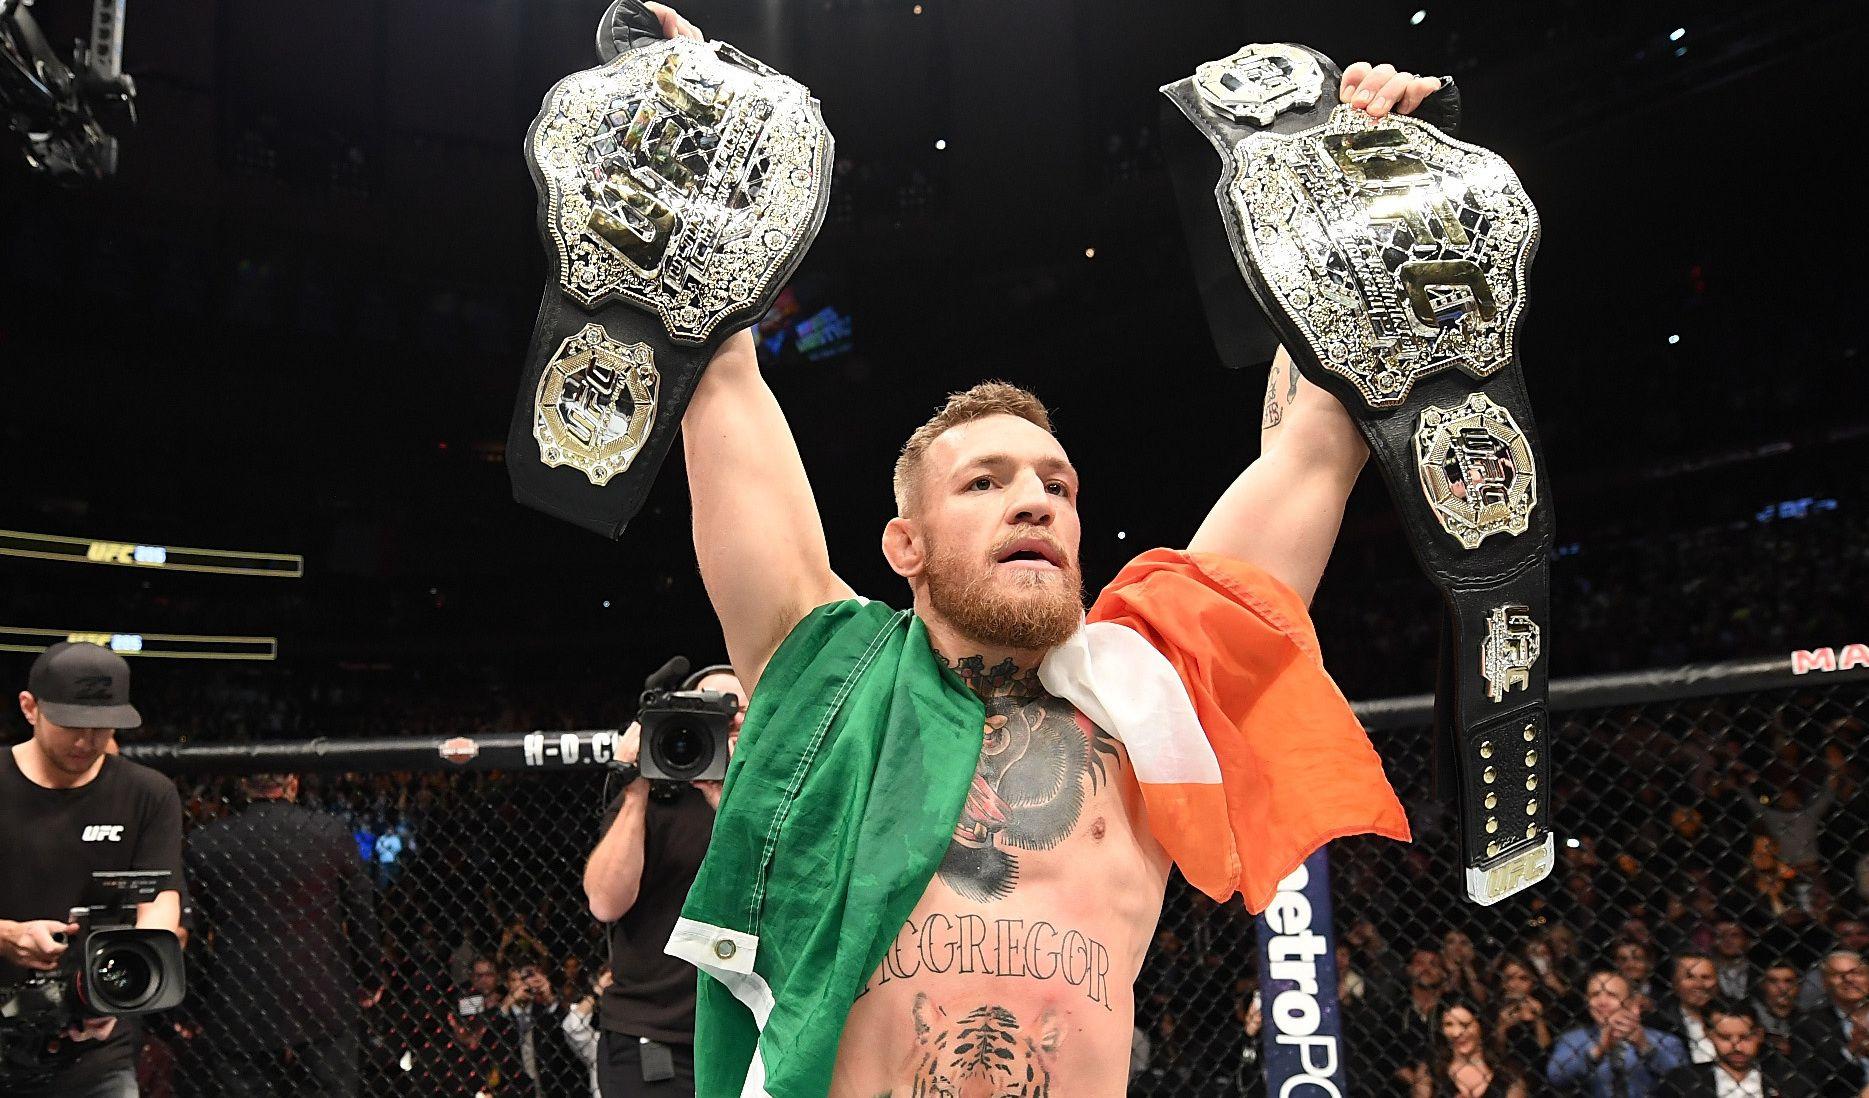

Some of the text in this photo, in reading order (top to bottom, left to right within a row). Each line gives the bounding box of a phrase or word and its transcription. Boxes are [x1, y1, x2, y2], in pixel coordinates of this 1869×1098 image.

[586, 53, 734, 280] UFC
[1322, 127, 1498, 335] UFC
[560, 357, 616, 447] UFC
[1460, 428, 1510, 506] UFC
[1791, 643, 1869, 675] MA
[82, 825, 124, 842] UFC
[1488, 848, 1547, 898] UFC
[854, 913, 1112, 1011] CGREGOR
